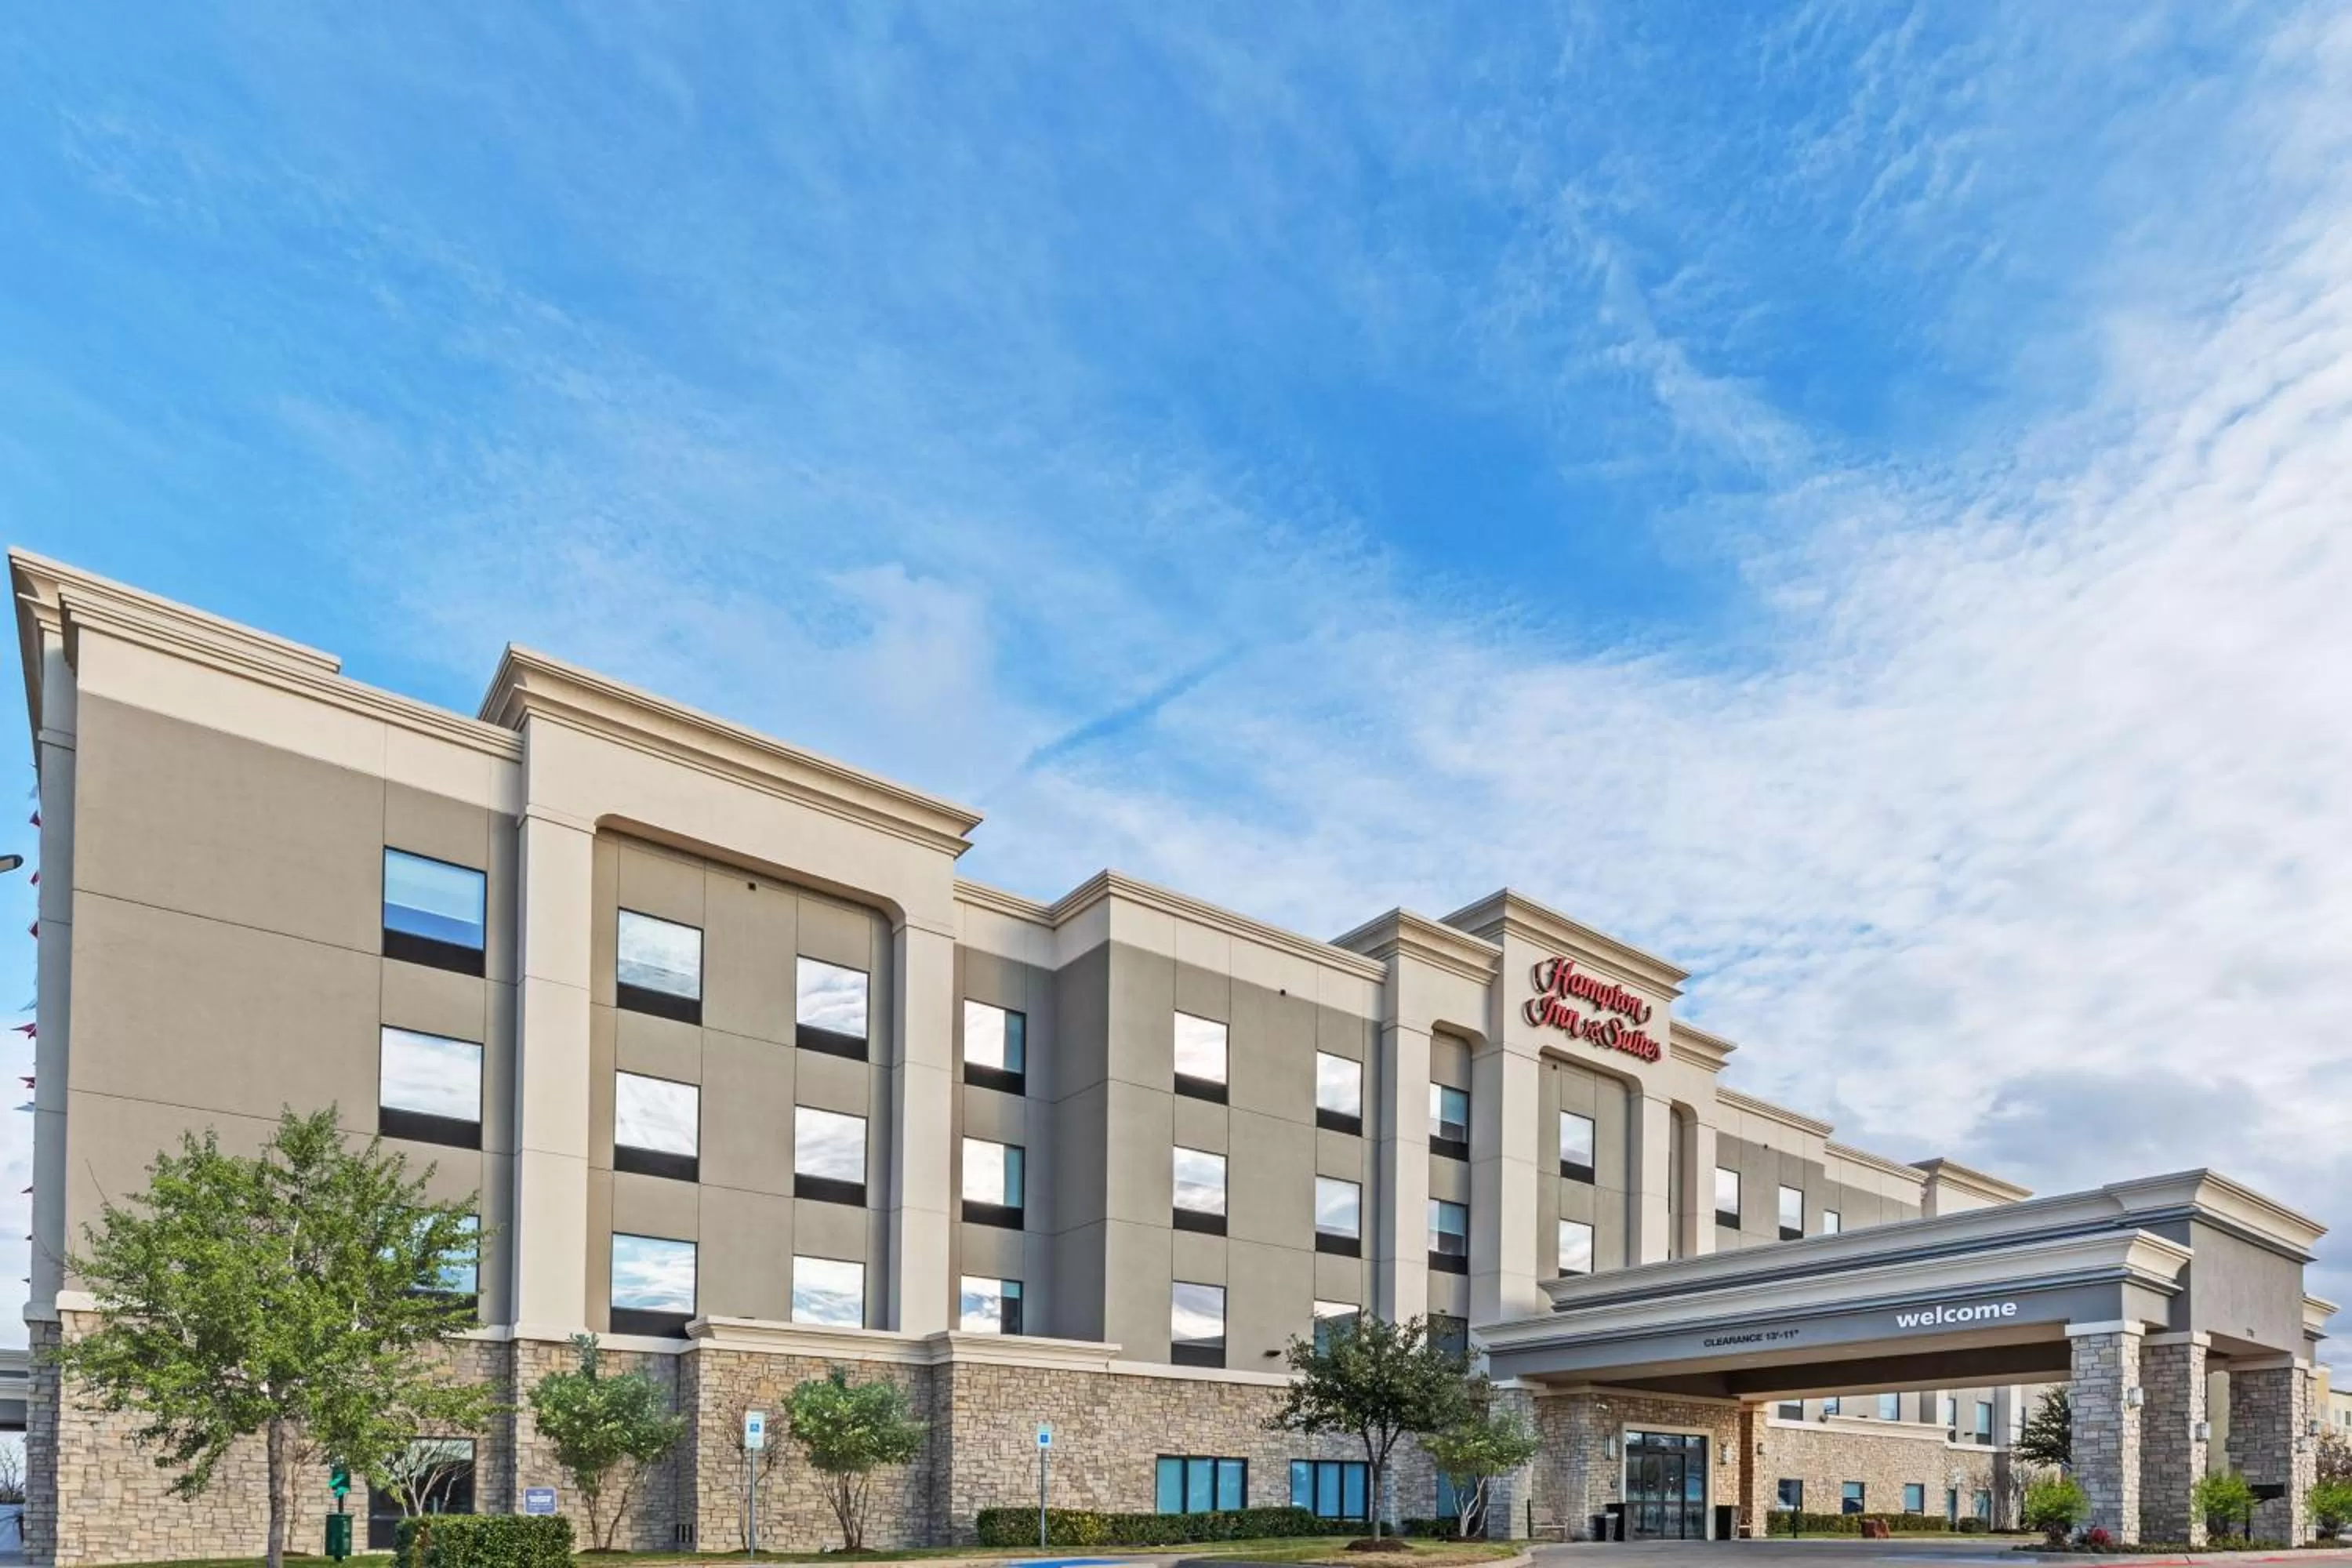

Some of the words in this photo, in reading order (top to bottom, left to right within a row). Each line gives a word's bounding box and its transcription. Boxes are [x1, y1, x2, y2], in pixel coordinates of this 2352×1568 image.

[1533, 956, 1652, 1025] Hampton
[1522, 995, 1585, 1040] Inn
[1600, 1018, 1661, 1063] Suites
[1896, 1301, 2017, 1327] welcome
[1703, 1333, 1763, 1347] CLEARANCE
